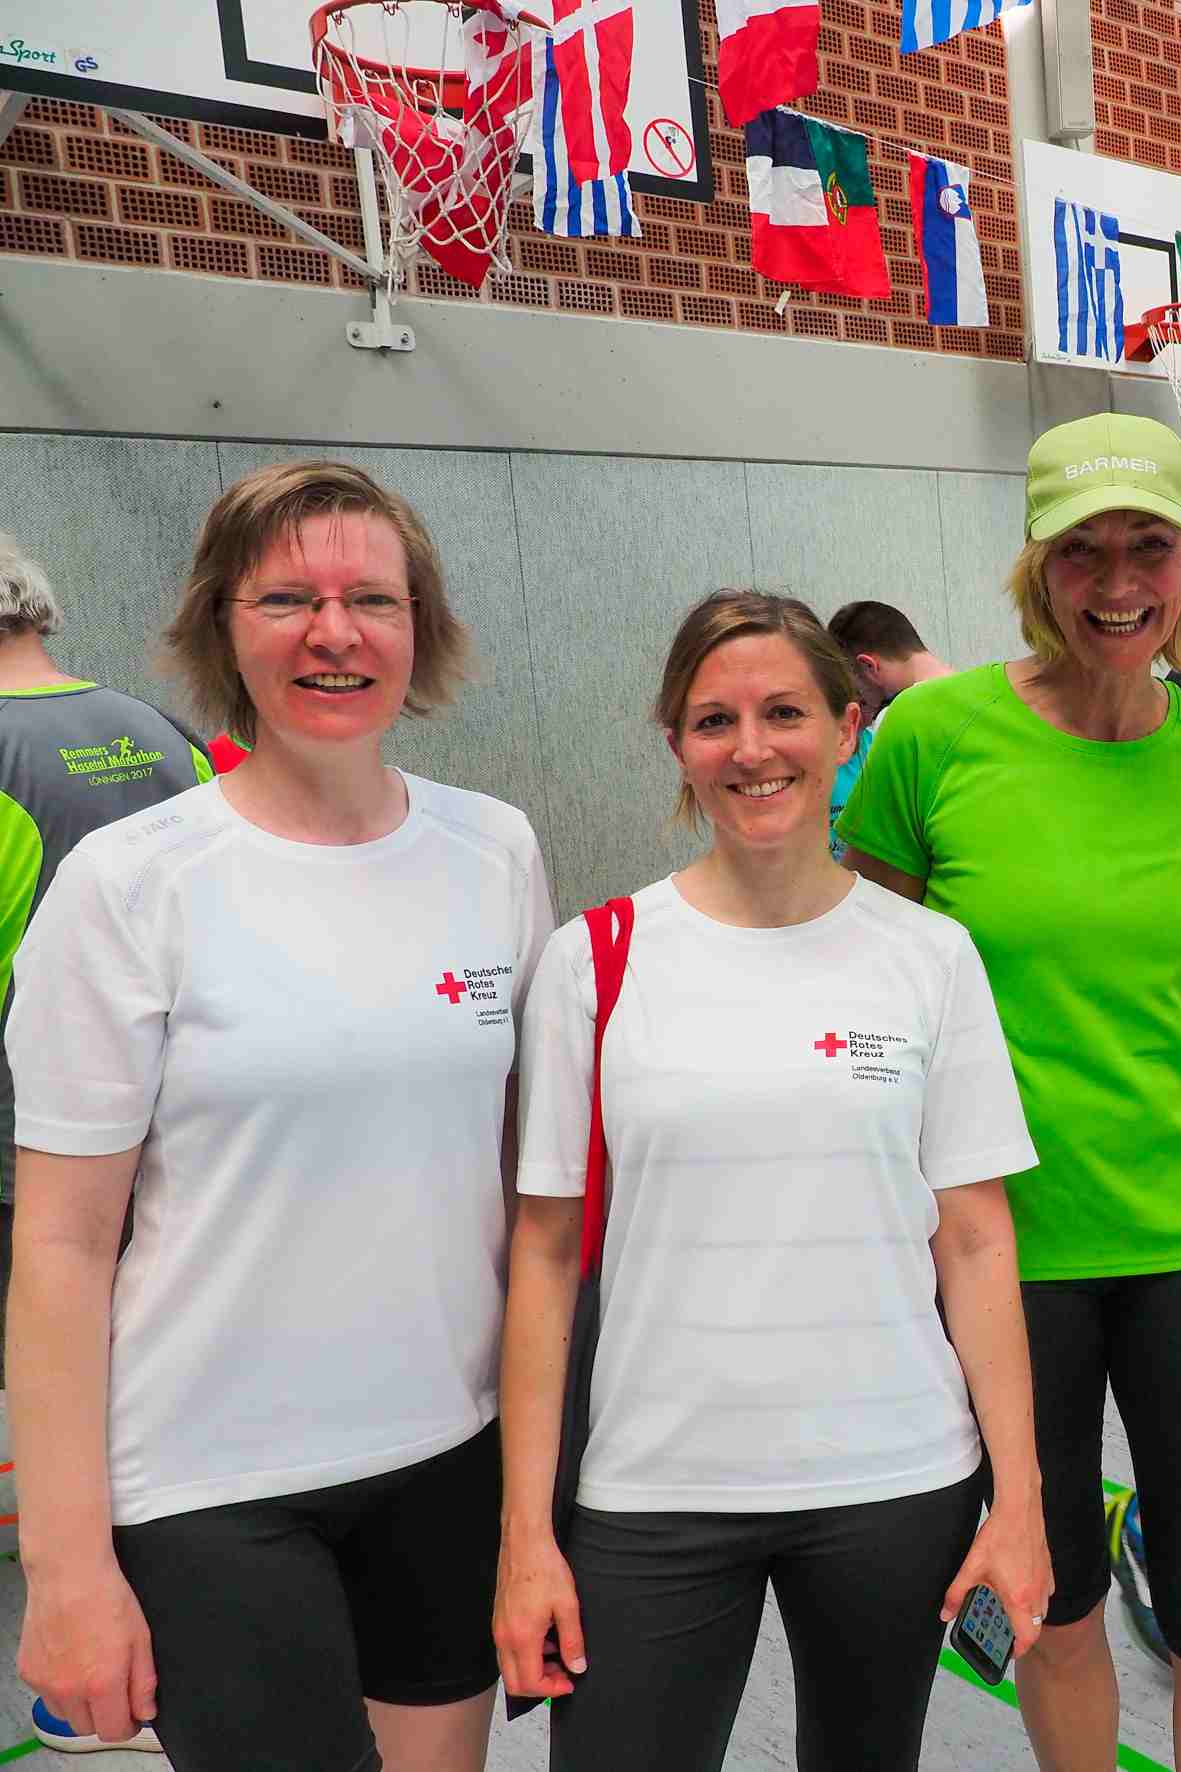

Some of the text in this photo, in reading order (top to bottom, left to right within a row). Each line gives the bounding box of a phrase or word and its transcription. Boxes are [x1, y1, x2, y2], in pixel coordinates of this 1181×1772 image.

[75, 57, 98, 73] GS
[1064, 456, 1158, 480] BARMER
[59, 746, 109, 760] Remmers
[67, 749, 166, 772] Hasetal Marathon
[130, 767, 153, 781] 2017
[464, 964, 512, 979] Deutsches
[467, 980, 495, 990] Rotes
[470, 991, 497, 1001] Kreuz
[848, 1031, 908, 1043] Deutsches
[849, 1040, 884, 1050] Rotes
[850, 1049, 885, 1058] Kreuz
